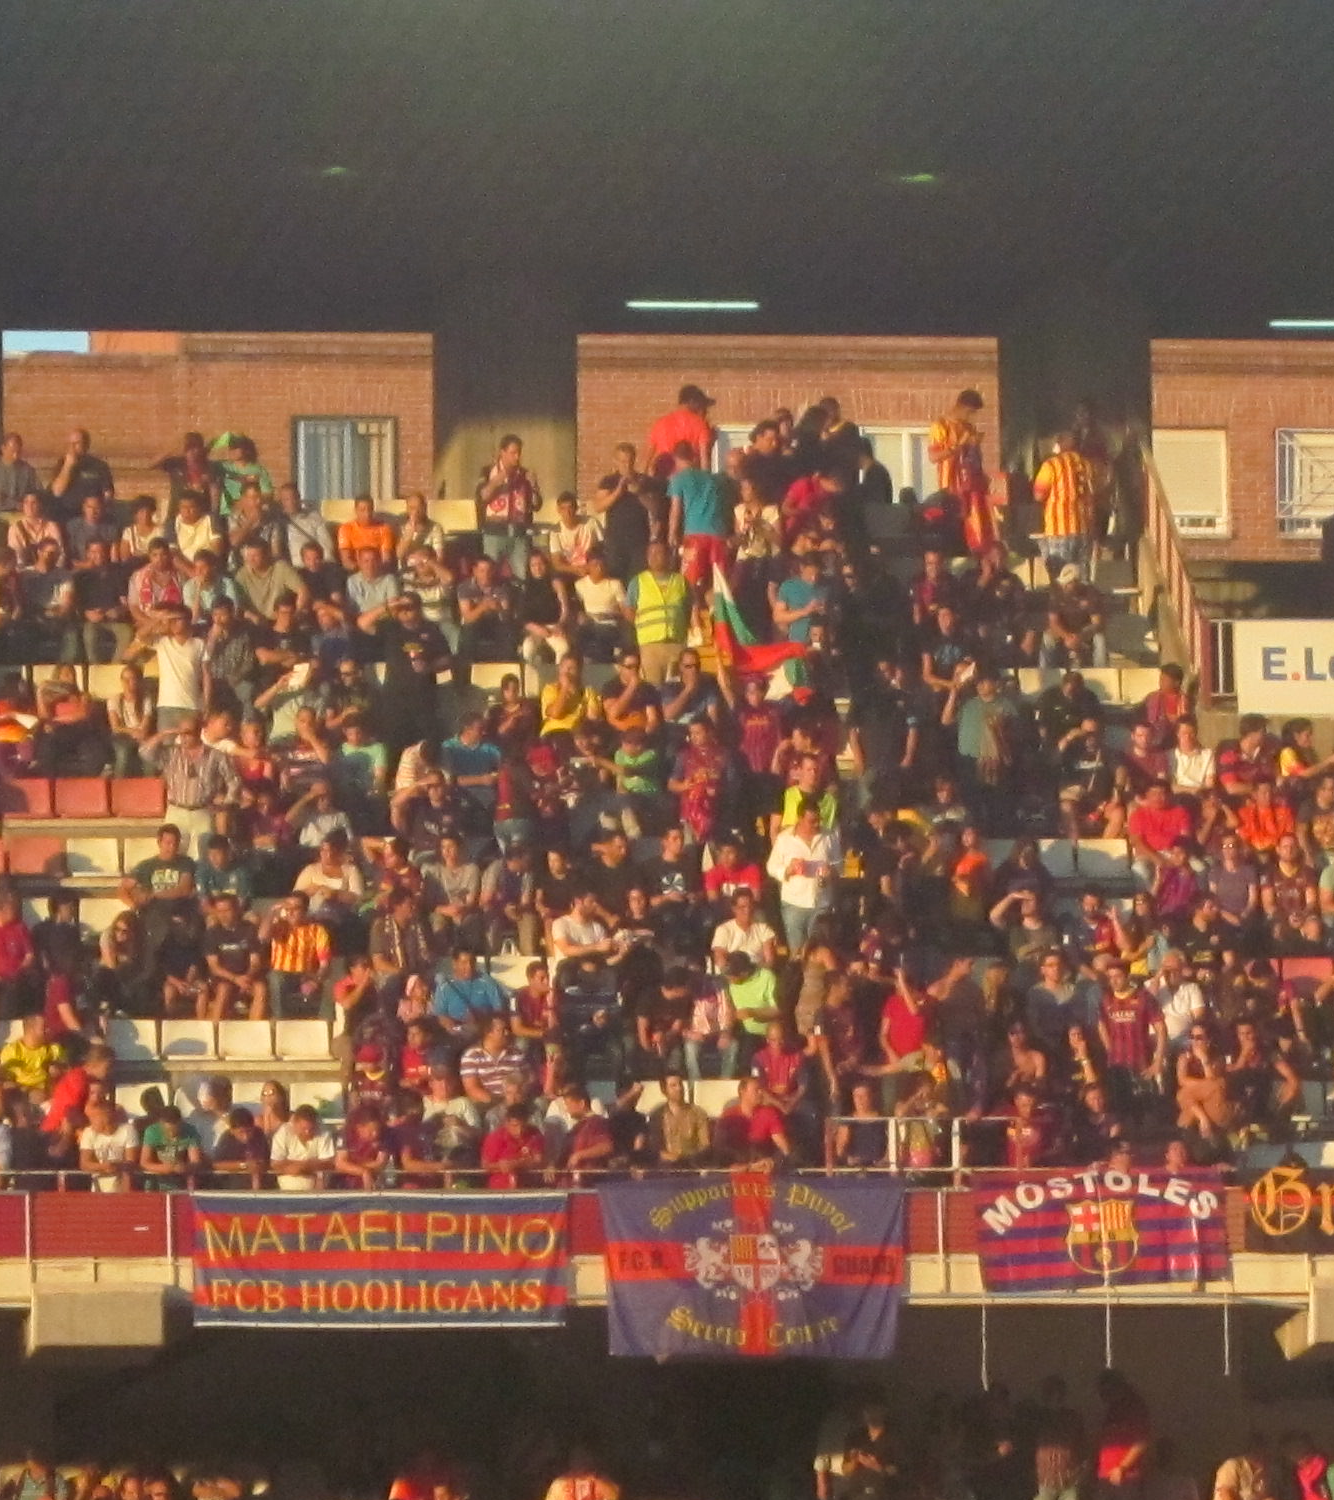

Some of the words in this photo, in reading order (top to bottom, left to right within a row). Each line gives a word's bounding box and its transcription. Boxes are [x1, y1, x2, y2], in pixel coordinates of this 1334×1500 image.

[204, 1210, 556, 1261] MATAELPINO
[211, 1279, 285, 1313] FCB
[301, 1279, 543, 1313] HOOLIGANS
